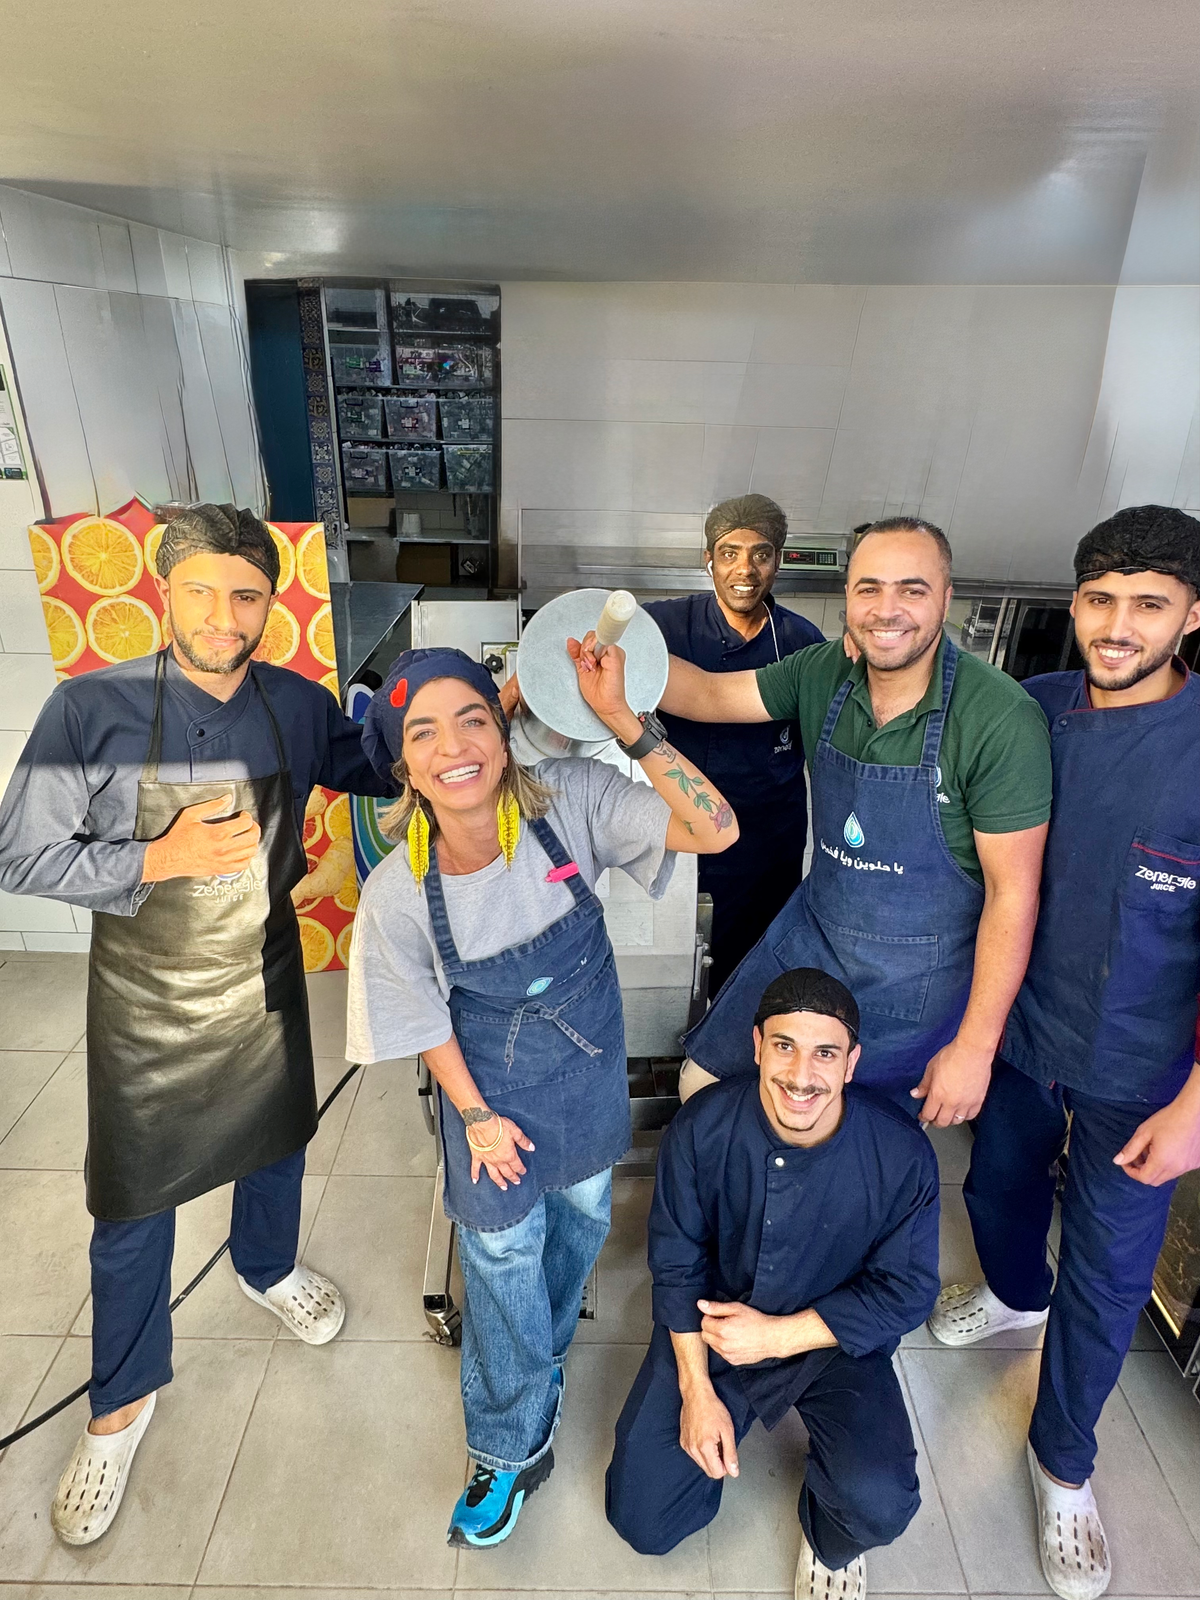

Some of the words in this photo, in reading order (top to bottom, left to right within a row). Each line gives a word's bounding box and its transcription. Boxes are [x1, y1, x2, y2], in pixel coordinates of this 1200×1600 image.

[839, 850, 853, 867] ويا
[853, 856, 891, 872] حلوين
[893, 861, 904, 875] يا
[1150, 883, 1176, 893] JUICE
[214, 893, 245, 904] JUICE
